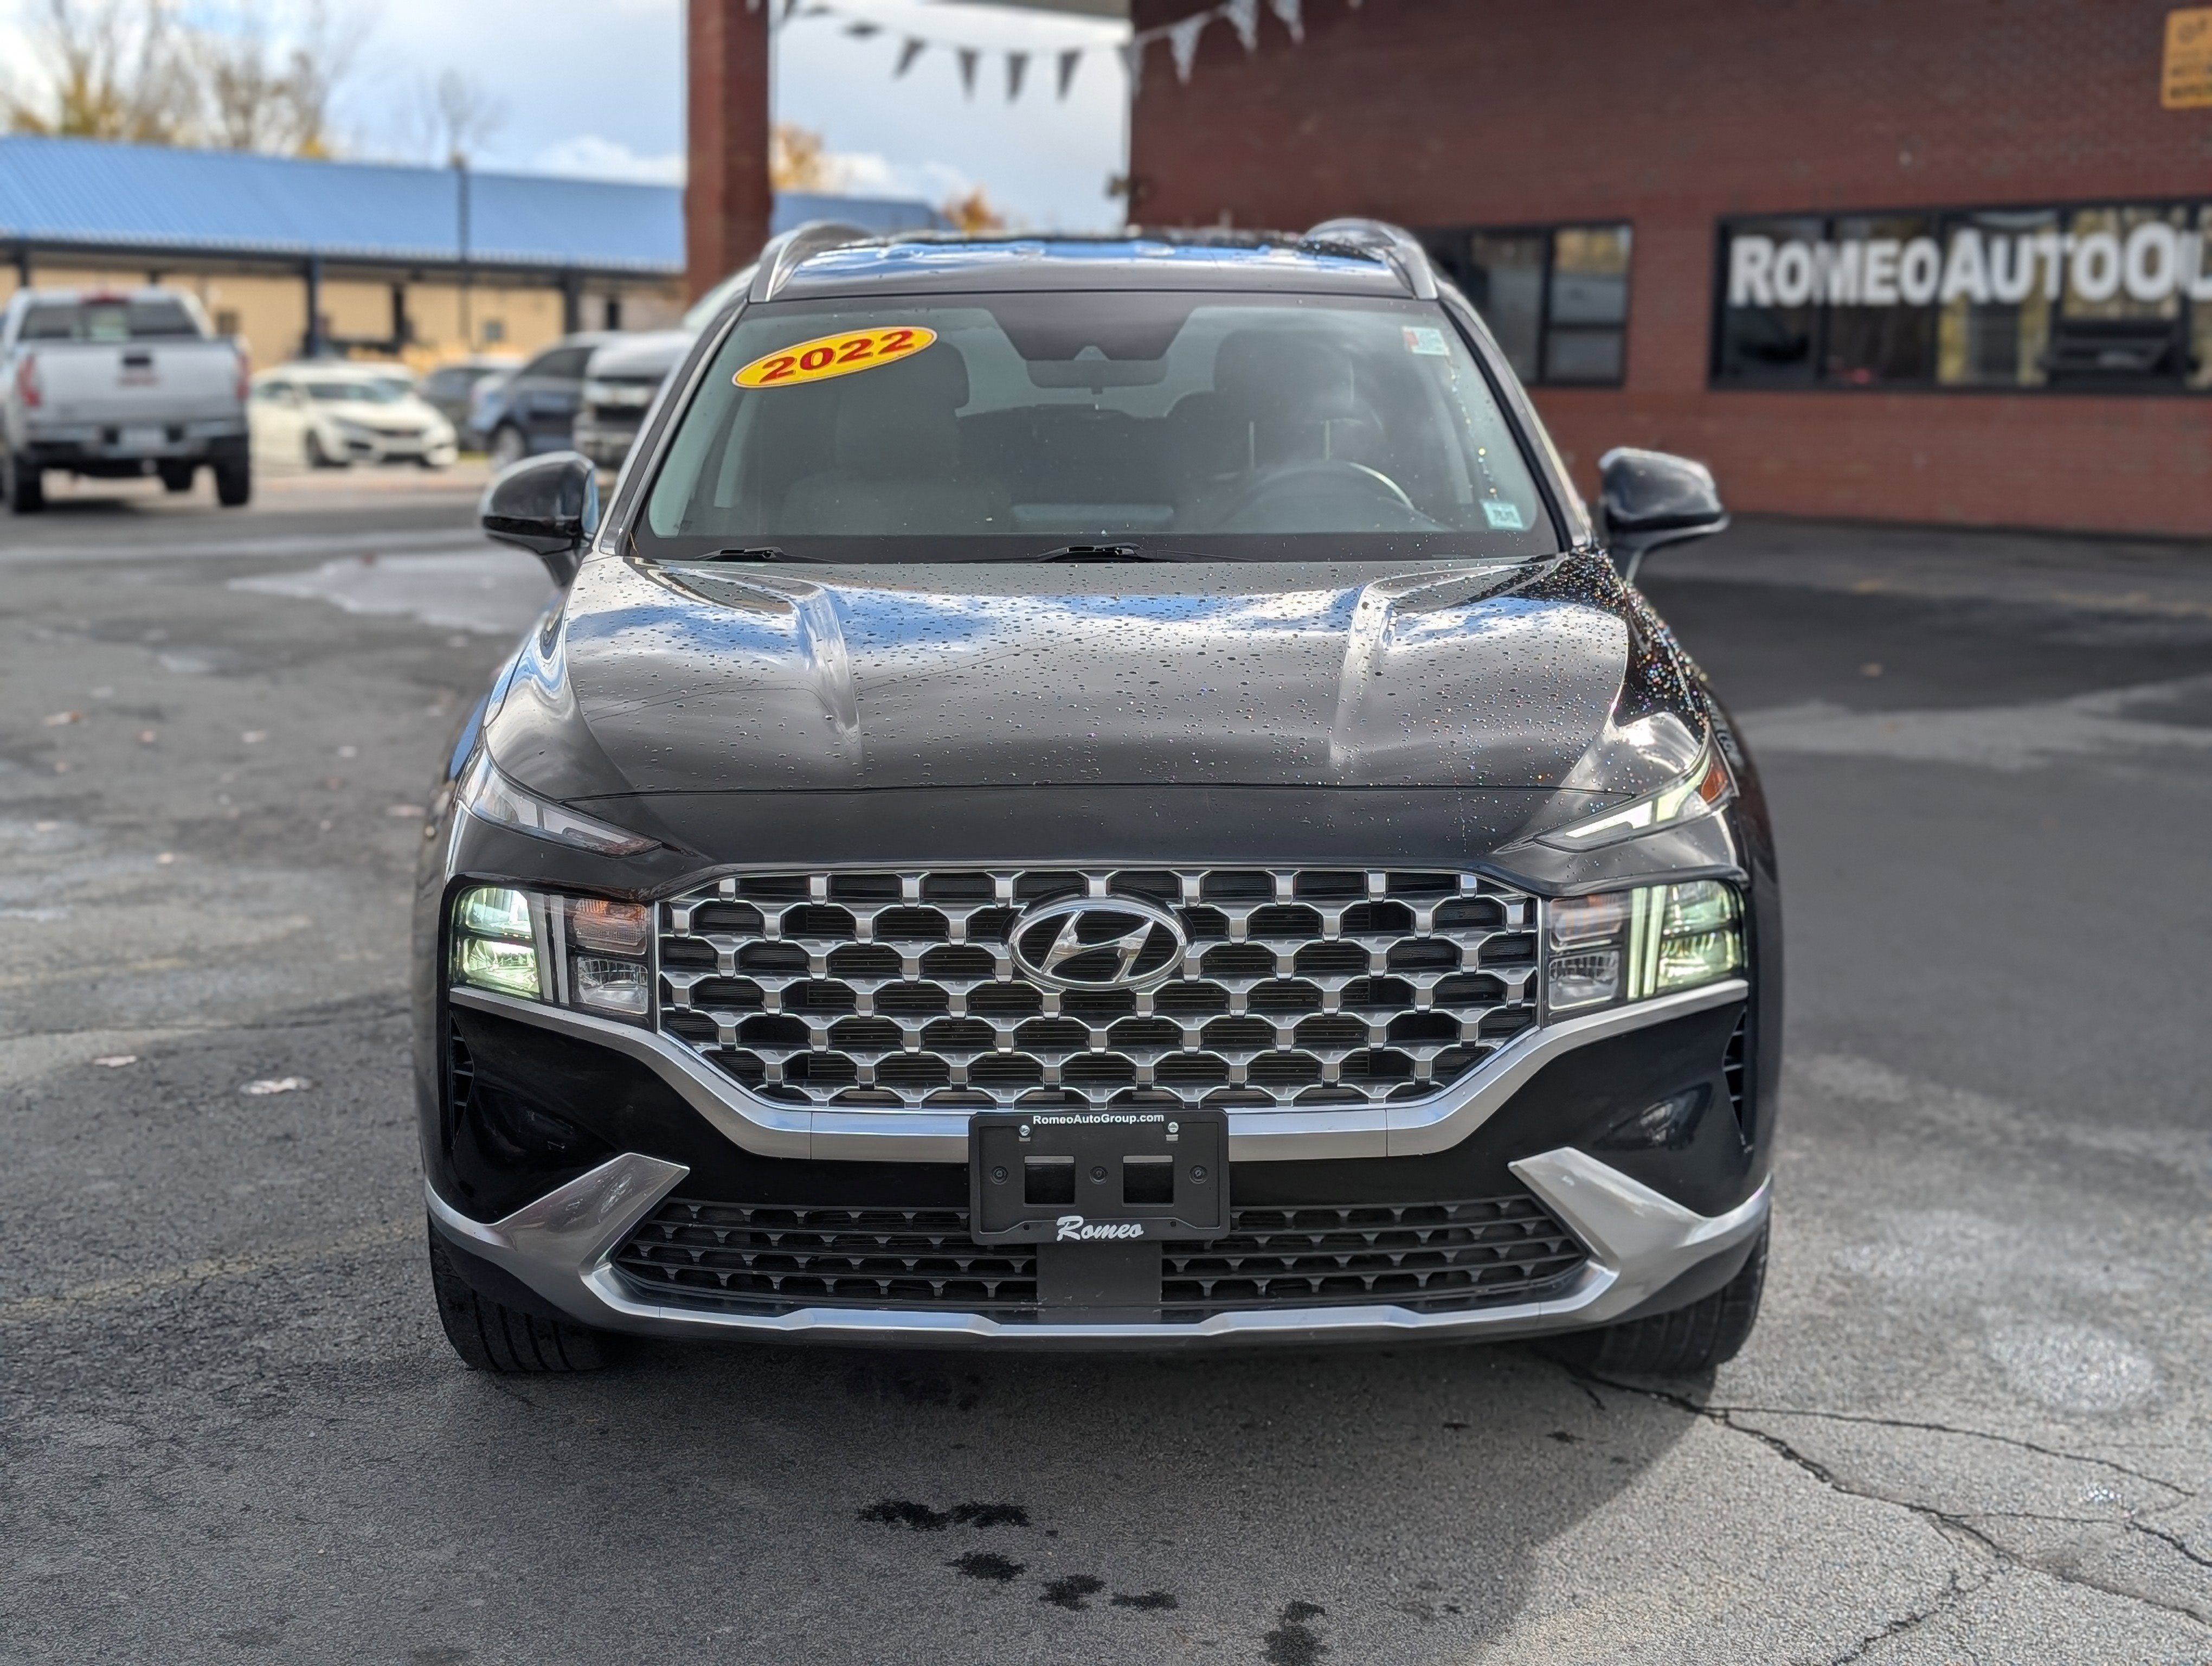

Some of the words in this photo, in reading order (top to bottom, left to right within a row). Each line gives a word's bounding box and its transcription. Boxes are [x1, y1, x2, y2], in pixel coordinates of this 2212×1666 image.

[759, 330, 915, 383] 2022
[1032, 1113, 1165, 1125] RomeoAutoGroup.com
[1056, 1215, 1144, 1241] Romeo
